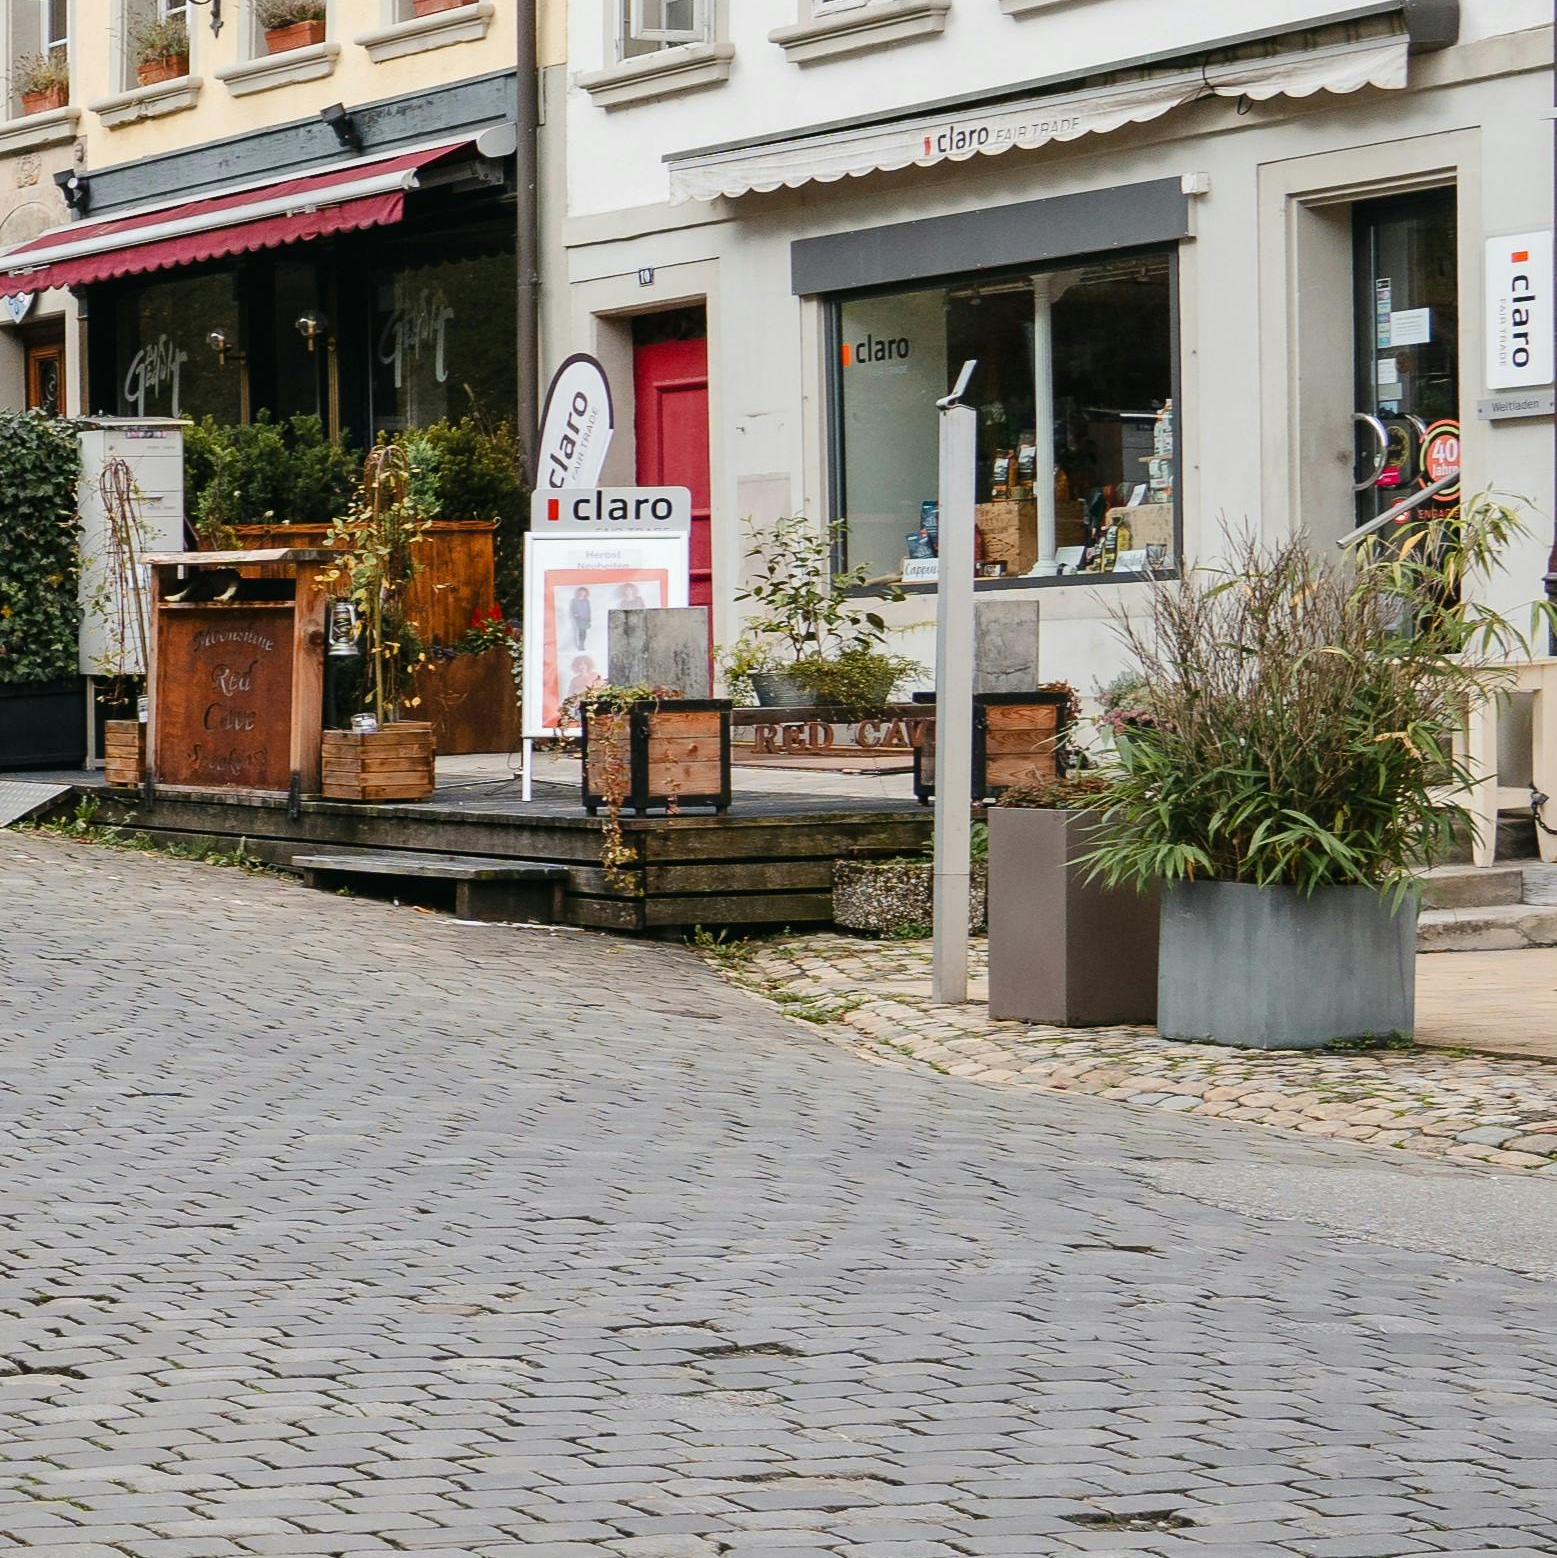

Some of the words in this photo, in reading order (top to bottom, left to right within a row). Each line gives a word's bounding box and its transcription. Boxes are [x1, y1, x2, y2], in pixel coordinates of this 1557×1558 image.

[937, 125, 990, 153] claro
[995, 126, 1027, 141] FAIR
[1031, 117, 1080, 136] TRADE
[639, 269, 651, 284] 10
[1512, 274, 1536, 368] claro
[855, 334, 910, 364] claro
[1491, 399, 1540, 413] Weltladen
[549, 391, 588, 489] claro
[580, 406, 600, 447] TRADE
[1432, 438, 1459, 463] 40
[573, 490, 672, 521] claro
[212, 660, 258, 696] Red
[751, 721, 834, 754] RED
